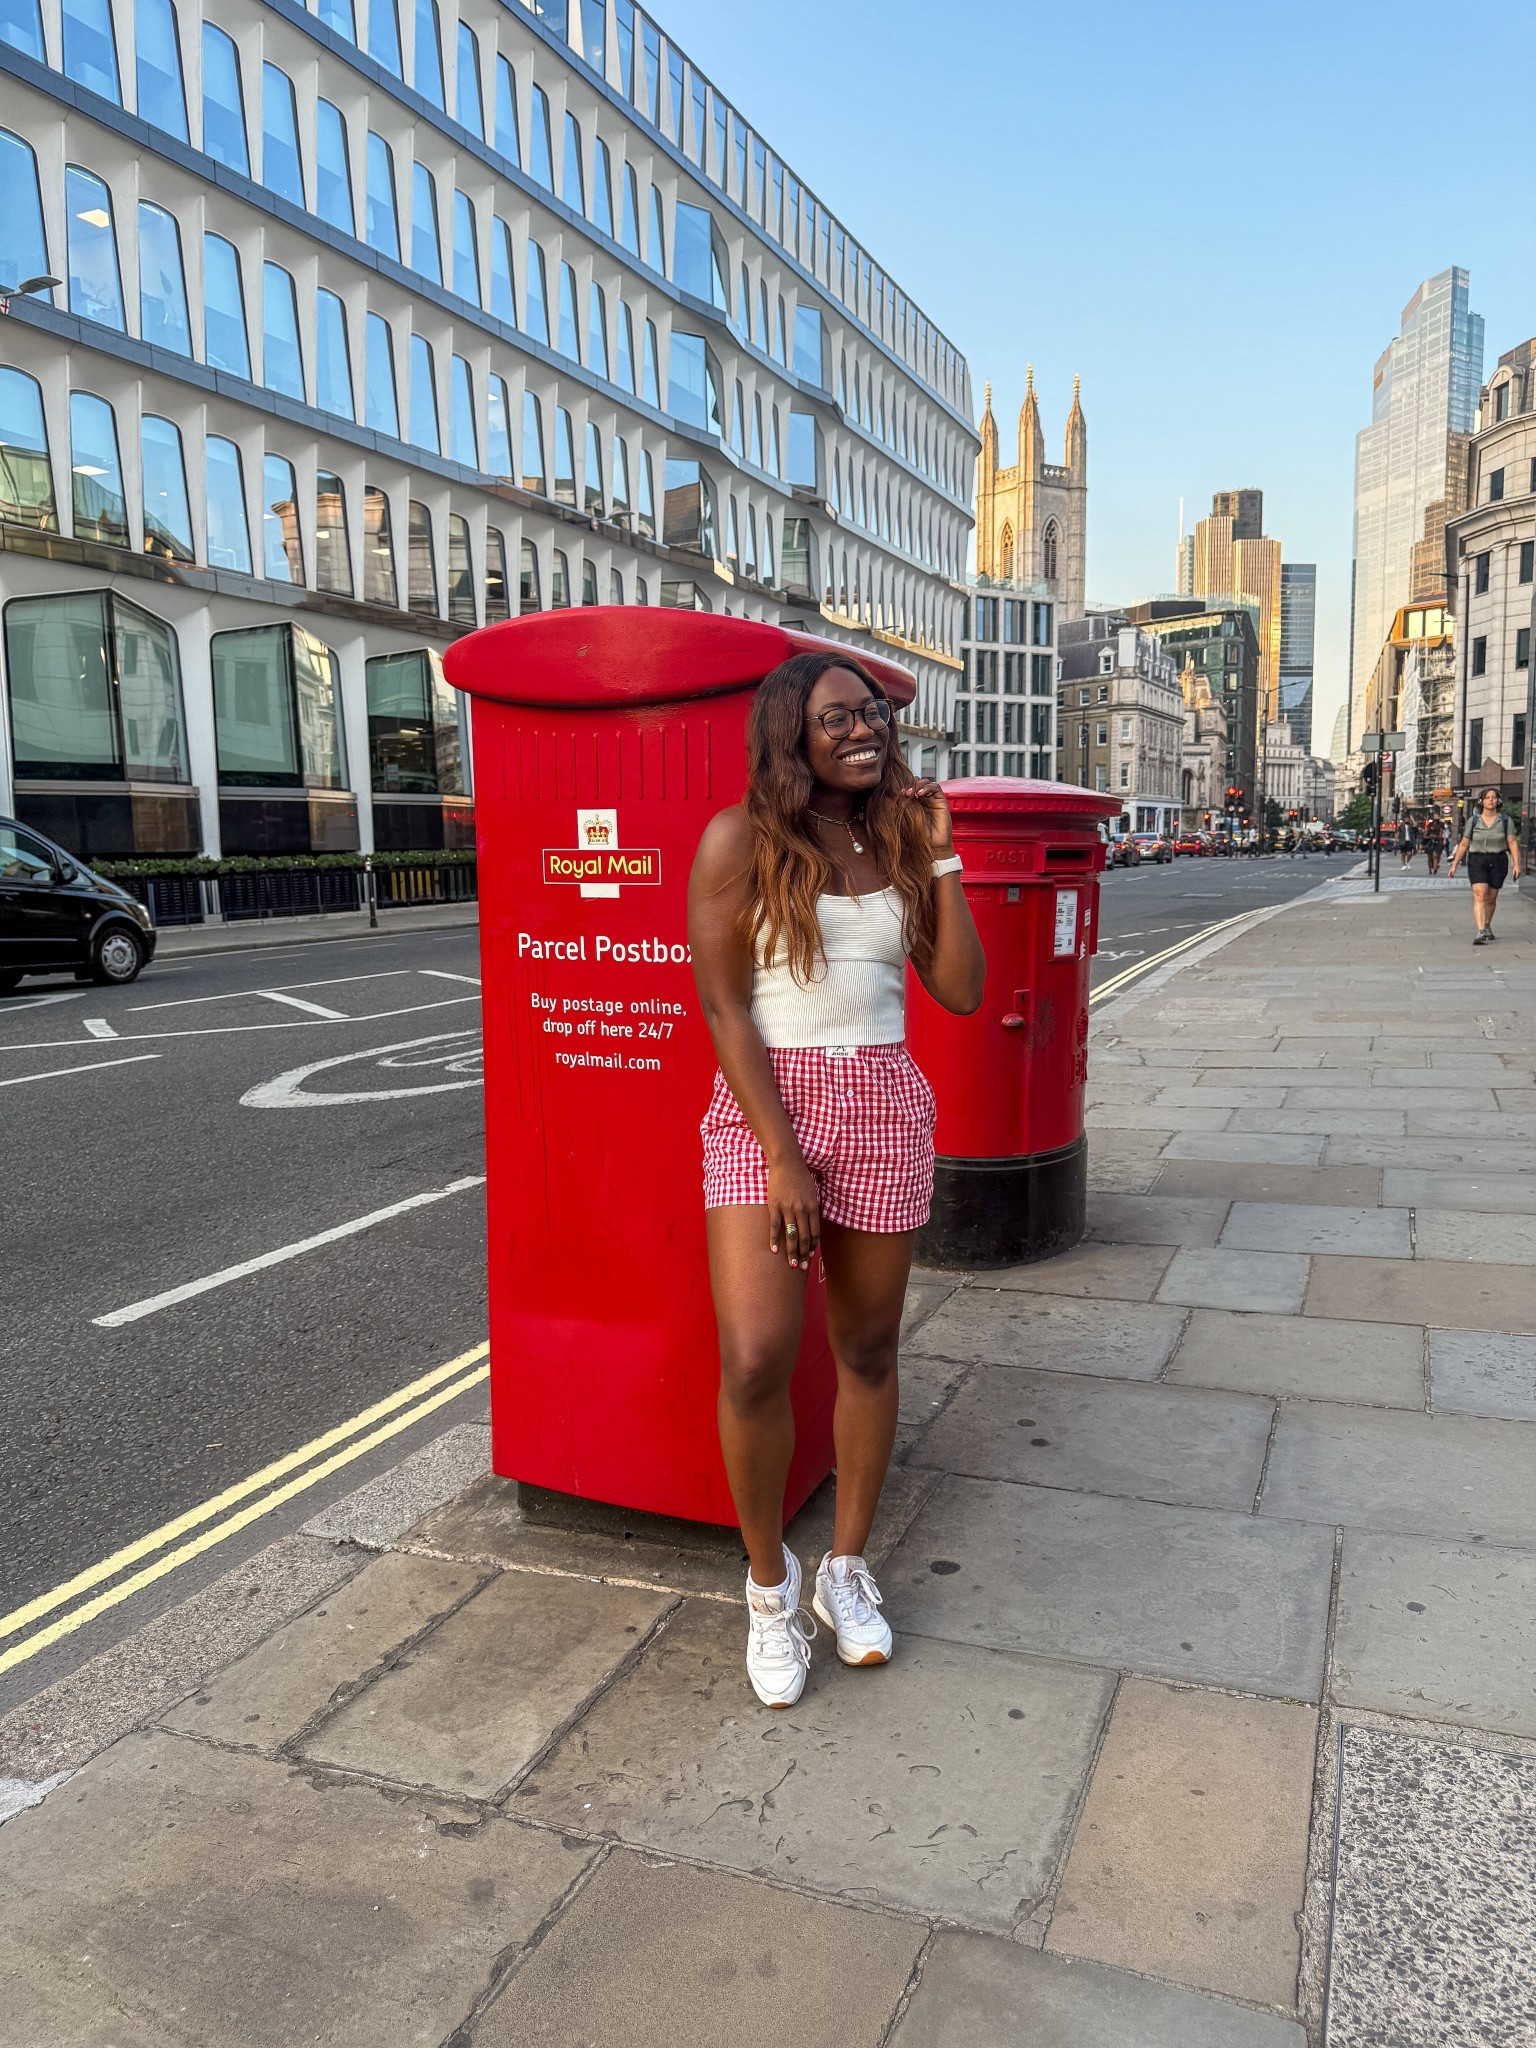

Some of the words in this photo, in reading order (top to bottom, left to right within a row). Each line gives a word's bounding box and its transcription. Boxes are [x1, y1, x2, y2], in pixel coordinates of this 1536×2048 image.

[550, 855, 602, 878] Royal
[607, 856, 652, 875] Mail
[985, 850, 1028, 865] POST
[518, 932, 587, 961] Parcel
[531, 993, 556, 1012] Buy
[562, 997, 624, 1017] postage
[630, 998, 687, 1017] online,
[543, 1018, 573, 1036] drop
[577, 1020, 596, 1035] off
[600, 1021, 633, 1037] here
[638, 1022, 674, 1039] 24/7
[555, 1051, 661, 1071] royalmail.com
